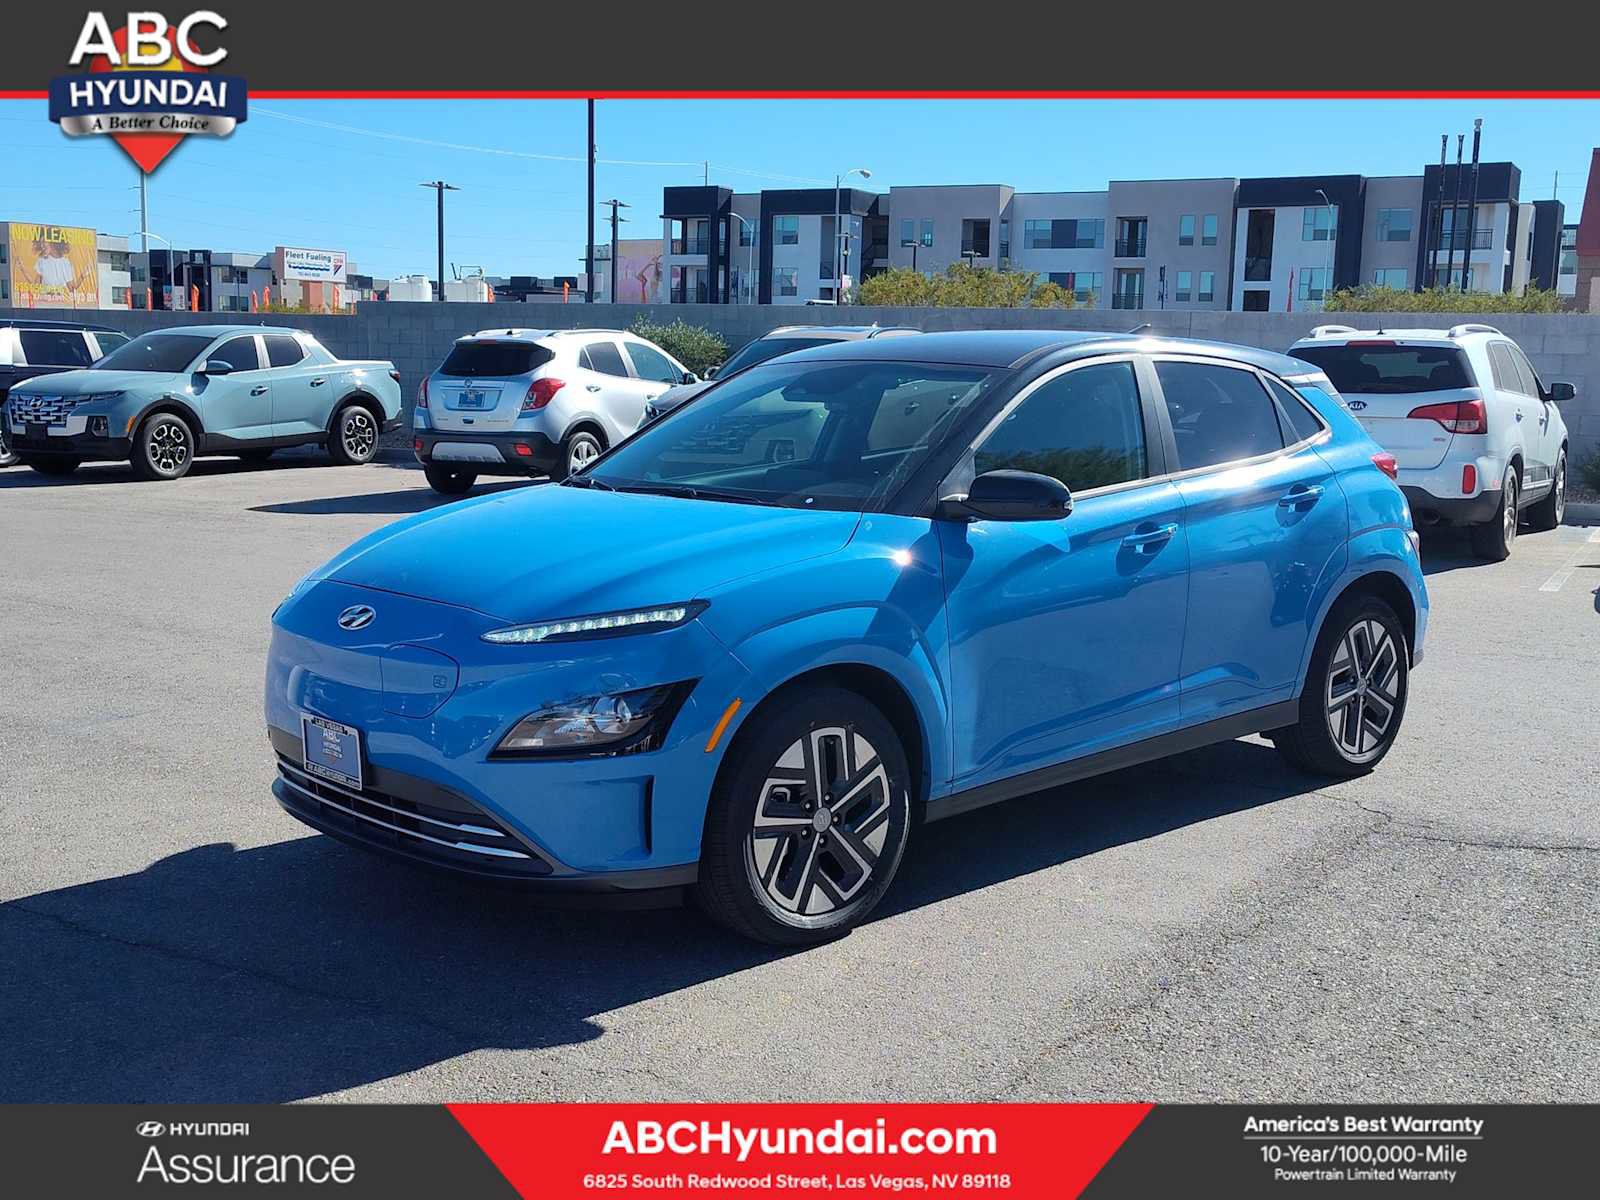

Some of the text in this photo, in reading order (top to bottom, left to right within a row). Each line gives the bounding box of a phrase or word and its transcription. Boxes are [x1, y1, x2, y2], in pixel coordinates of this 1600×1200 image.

[12, 224, 94, 246] NOW LEASING
[285, 250, 332, 263] Fleet Fueling
[1348, 401, 1366, 410] KIA
